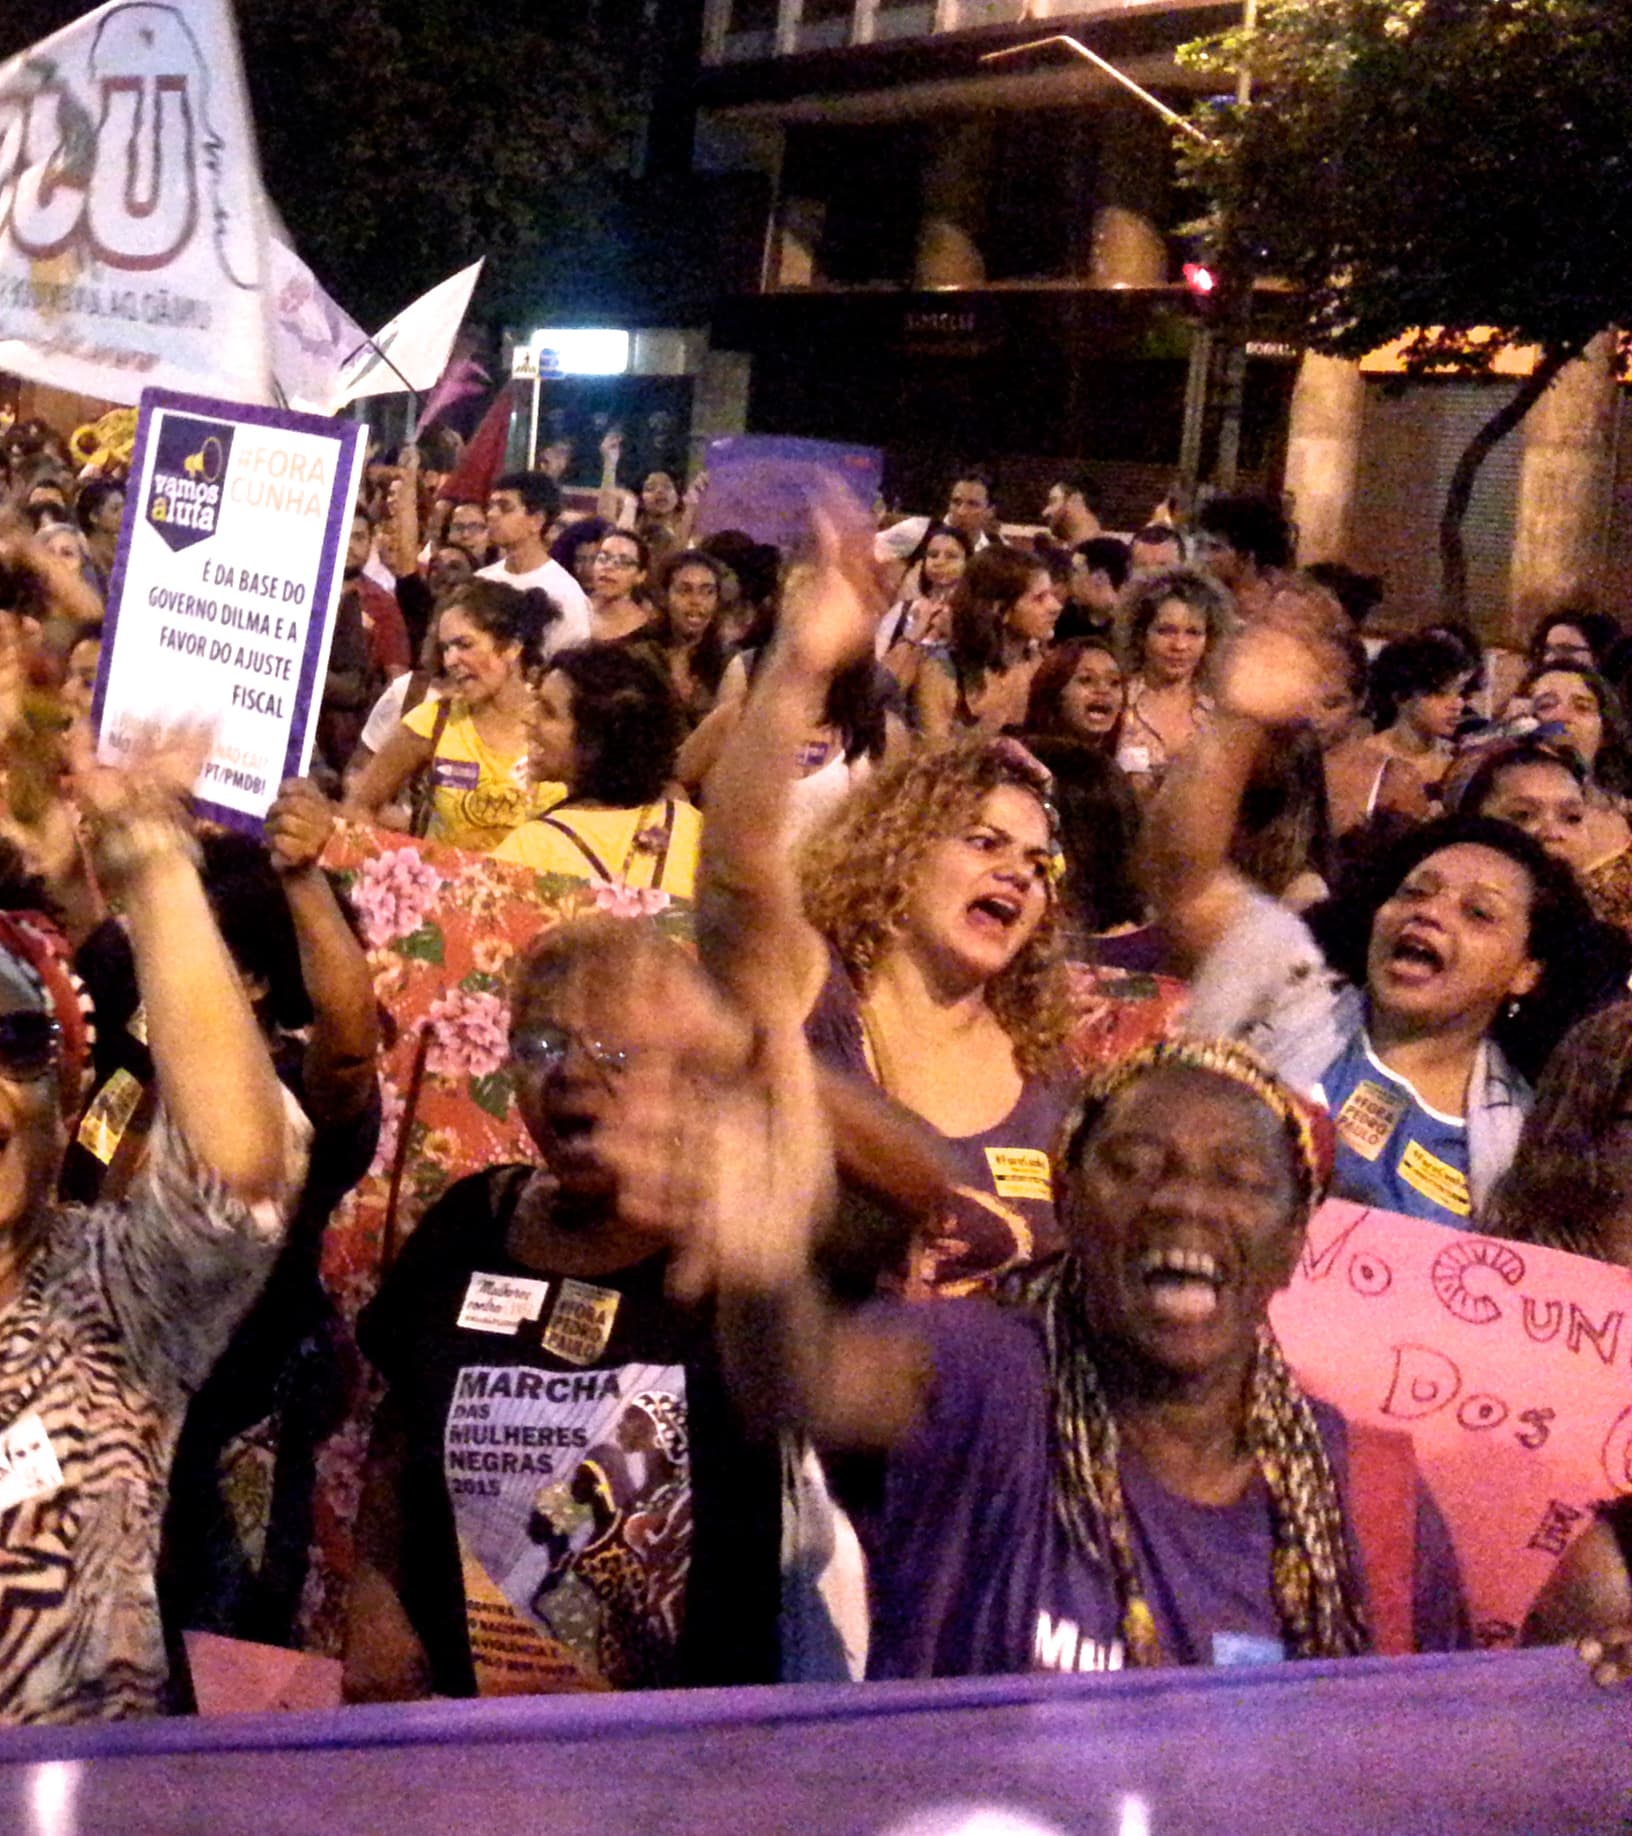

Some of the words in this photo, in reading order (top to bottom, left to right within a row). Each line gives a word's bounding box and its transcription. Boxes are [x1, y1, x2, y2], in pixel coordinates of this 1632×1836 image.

[237, 446, 326, 486] #FORA
[154, 473, 220, 504] vamos
[230, 476, 322, 518] CUNHA
[201, 557, 213, 582] É
[214, 564, 235, 588] DA
[238, 569, 279, 599] BASE
[281, 580, 306, 605] DO
[148, 585, 218, 623] GOVERNO
[220, 604, 271, 637] DILMA
[274, 617, 285, 640] E
[286, 621, 298, 644] A
[159, 625, 208, 658] FAVOR
[208, 639, 233, 664] DO
[234, 647, 293, 682] AJUSTE
[231, 684, 284, 719] FISCAL
[204, 761, 267, 797] PT/PMDB!
[1431, 1238, 1632, 1366] CUN
[458, 1371, 621, 1404] MARCHA
[453, 1403, 491, 1420] DAS
[449, 1424, 588, 1448] MULHERES
[449, 1450, 553, 1474] NEGRAS
[451, 1477, 501, 1497] 2015
